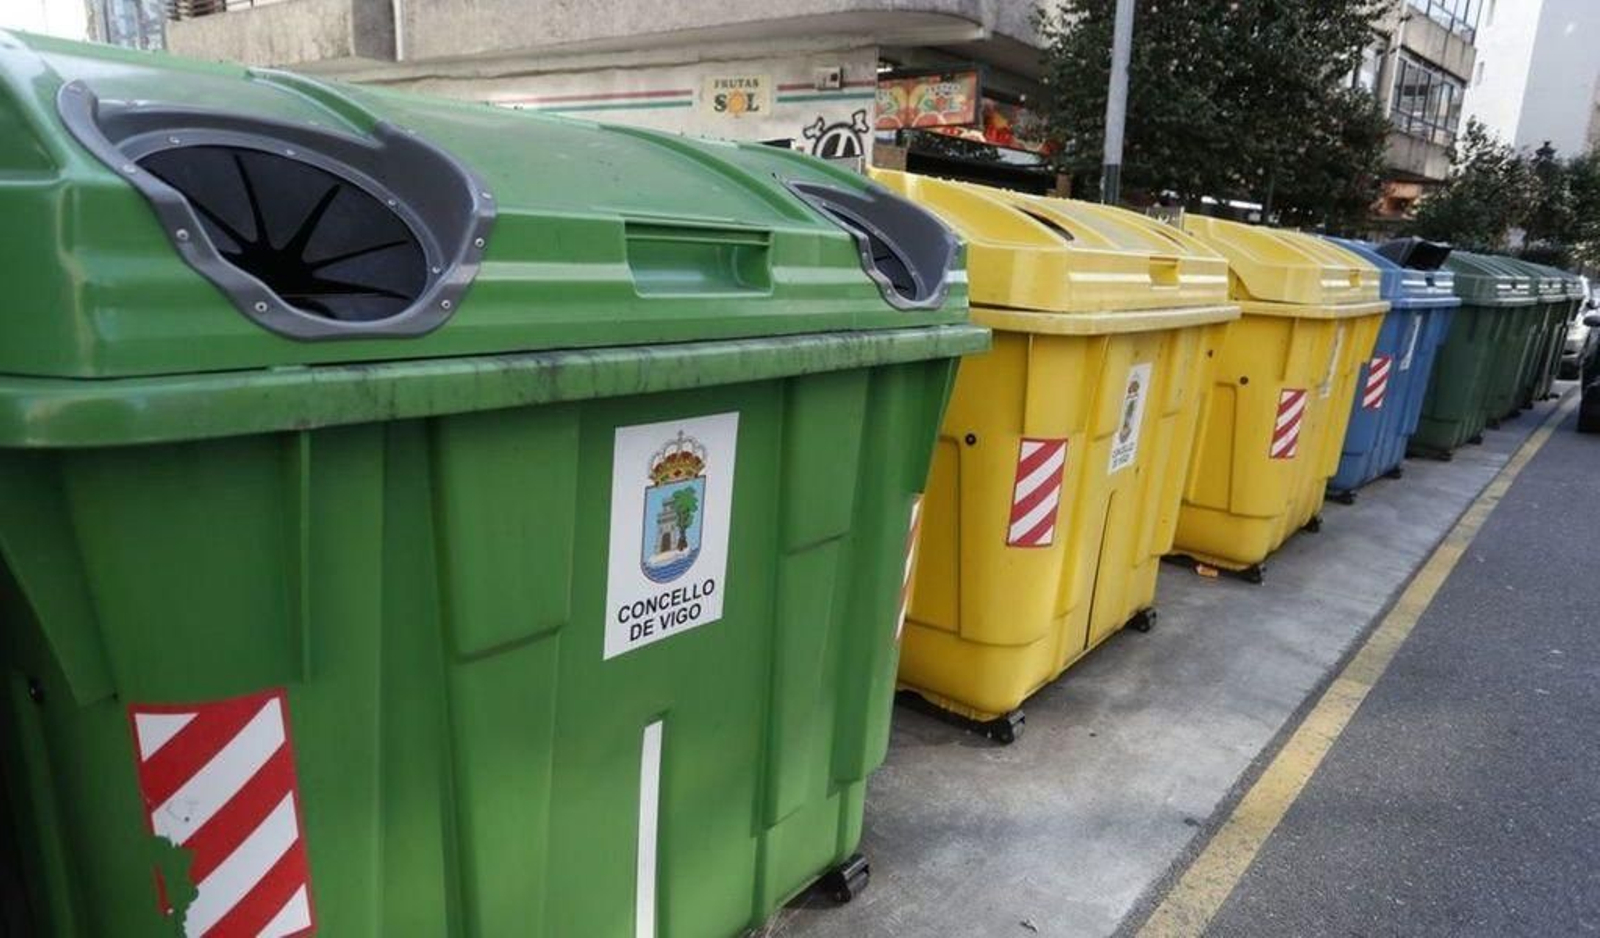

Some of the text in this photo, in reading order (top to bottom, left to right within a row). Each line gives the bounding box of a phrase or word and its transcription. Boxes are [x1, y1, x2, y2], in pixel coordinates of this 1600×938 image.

[714, 79, 759, 89] FRUTAS
[618, 579, 715, 624] CONCELLO
[630, 603, 702, 641] DE VIGO
